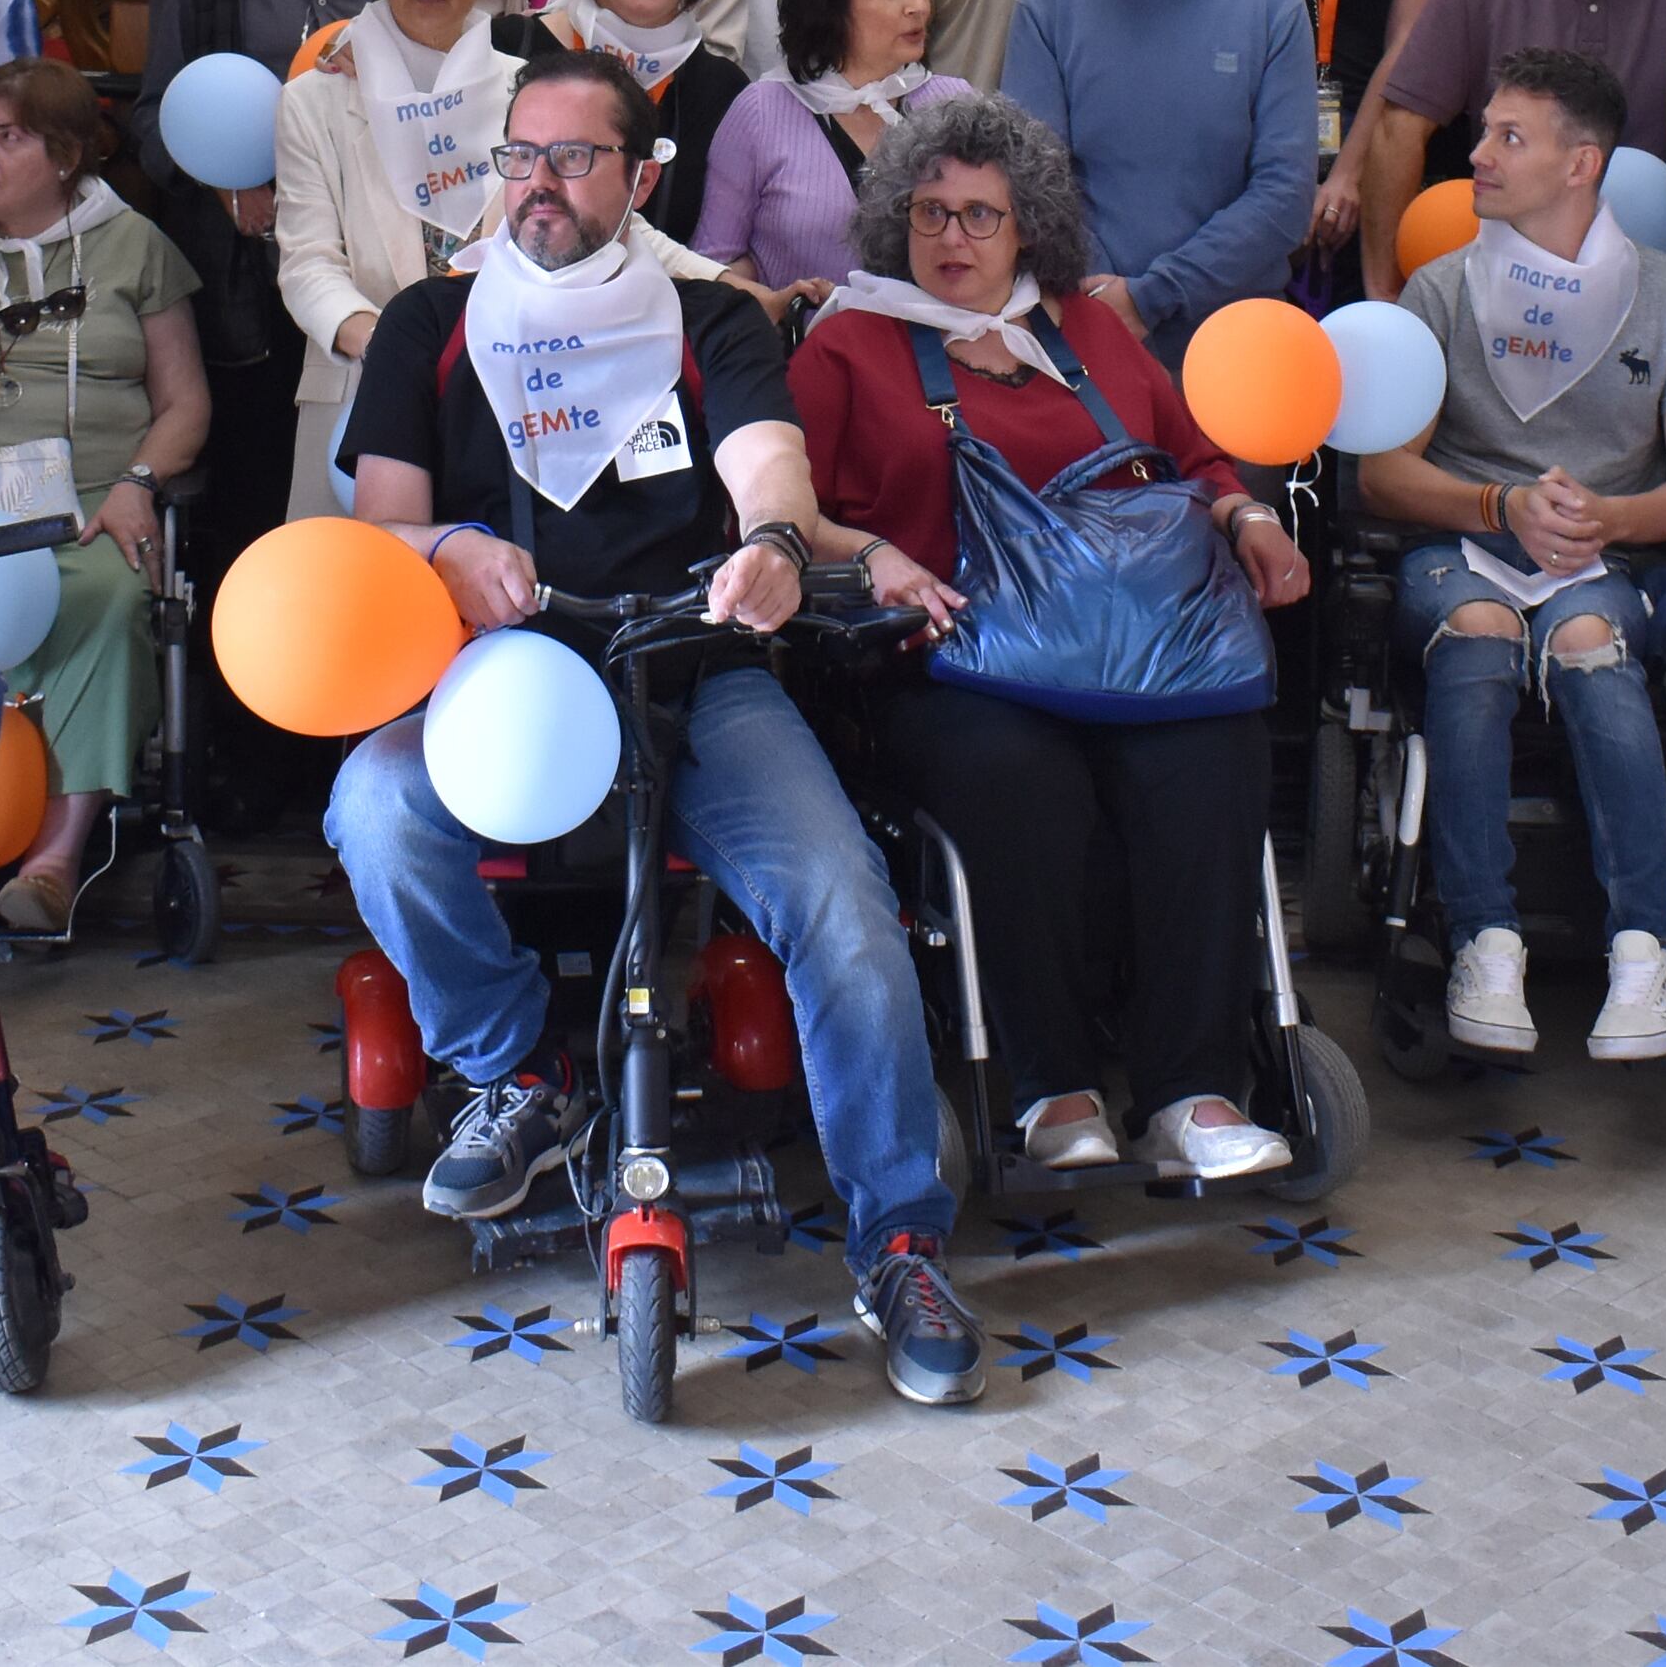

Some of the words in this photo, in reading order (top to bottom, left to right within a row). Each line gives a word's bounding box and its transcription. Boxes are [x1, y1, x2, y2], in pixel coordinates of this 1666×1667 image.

[396, 89, 464, 123] marea
[428, 134, 457, 156] de
[415, 161, 491, 207] gEMte
[1508, 261, 1582, 294] marea
[1523, 305, 1554, 326] de
[1491, 335, 1574, 363] gEMte
[526, 368, 564, 392] de
[507, 405, 601, 449] gEMte
[631, 441, 661, 455] FACE
